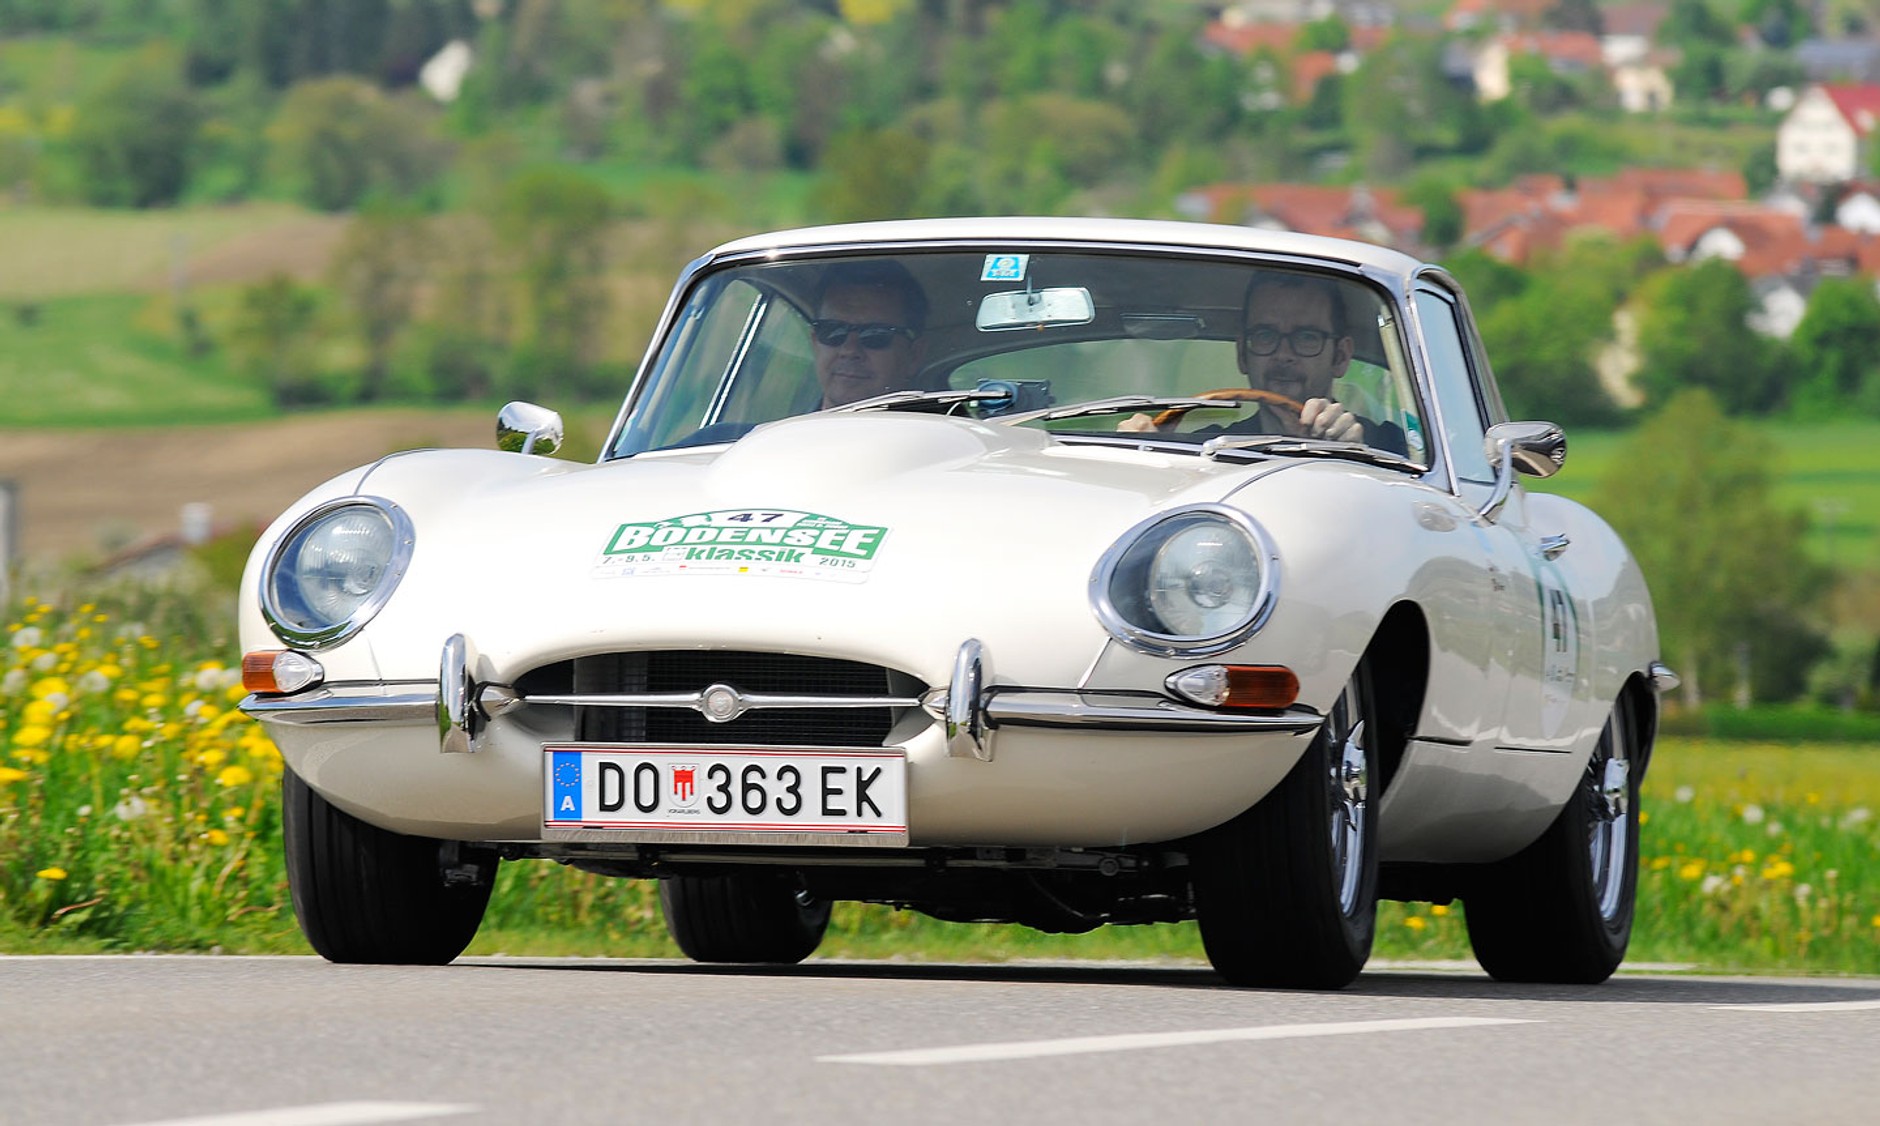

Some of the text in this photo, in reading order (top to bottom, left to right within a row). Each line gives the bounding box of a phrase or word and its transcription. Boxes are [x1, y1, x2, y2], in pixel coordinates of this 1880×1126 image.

[727, 513, 784, 523] 47
[610, 525, 881, 556] BODENSEE
[685, 547, 806, 563] klassik
[819, 557, 856, 569] 2015
[598, 761, 882, 818] DO 363 EK
[560, 796, 576, 812] A
